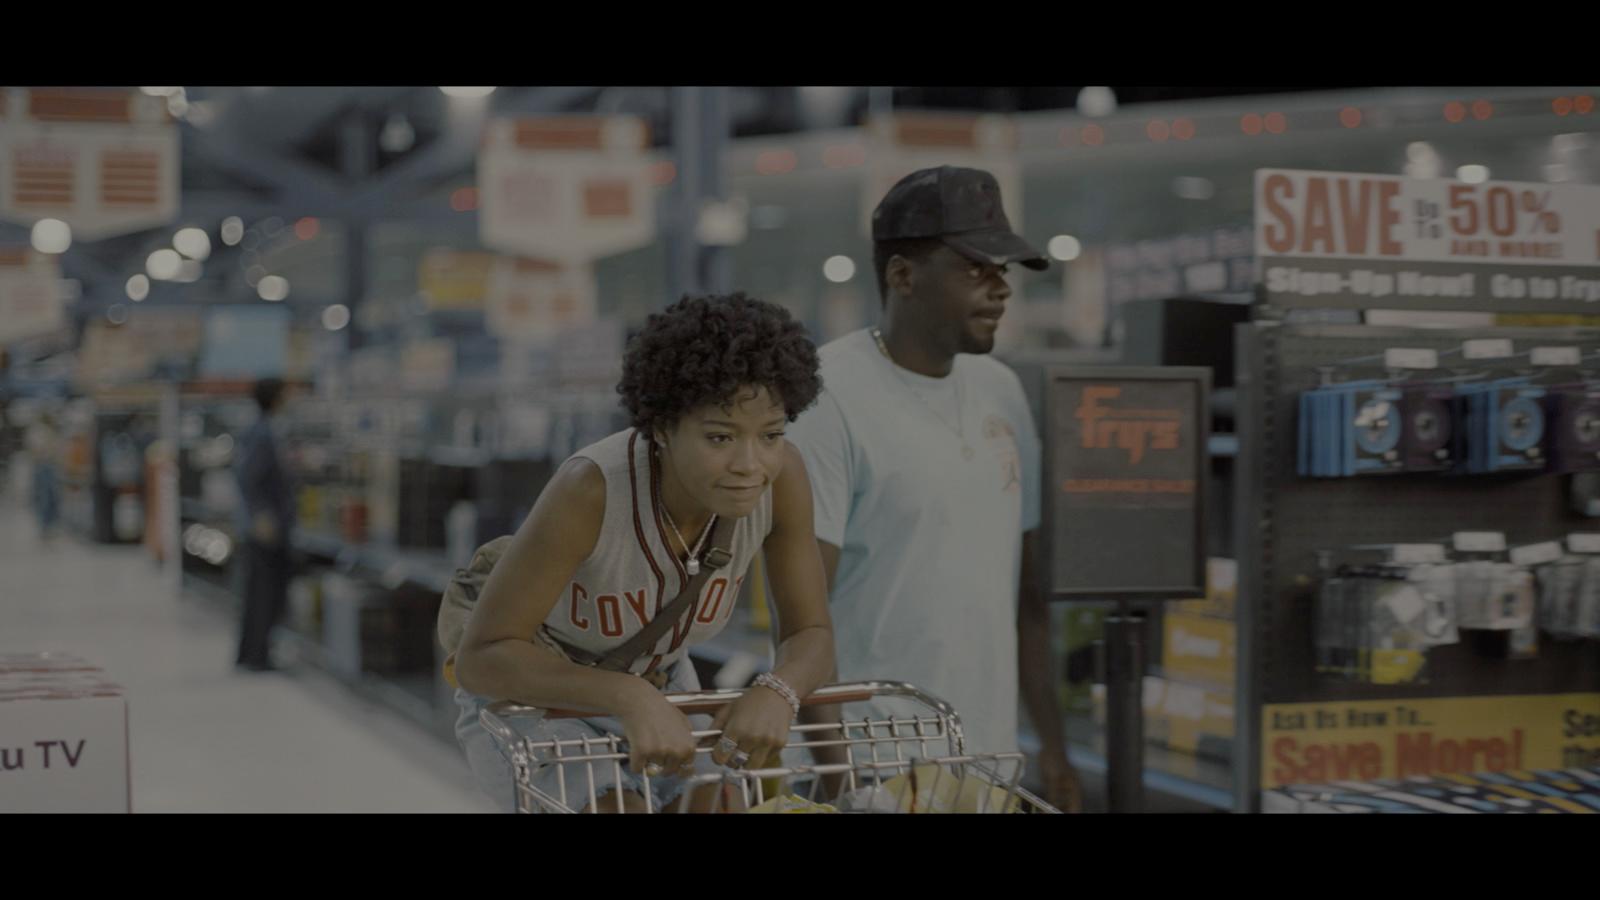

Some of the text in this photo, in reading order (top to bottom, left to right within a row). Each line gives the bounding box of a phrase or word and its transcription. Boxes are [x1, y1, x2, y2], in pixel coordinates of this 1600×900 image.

[1264, 174, 1402, 255] SAVE
[1448, 183, 1562, 237] 50%
[0, 739, 86, 771] u TV
[1273, 728, 1523, 784] Save More!
